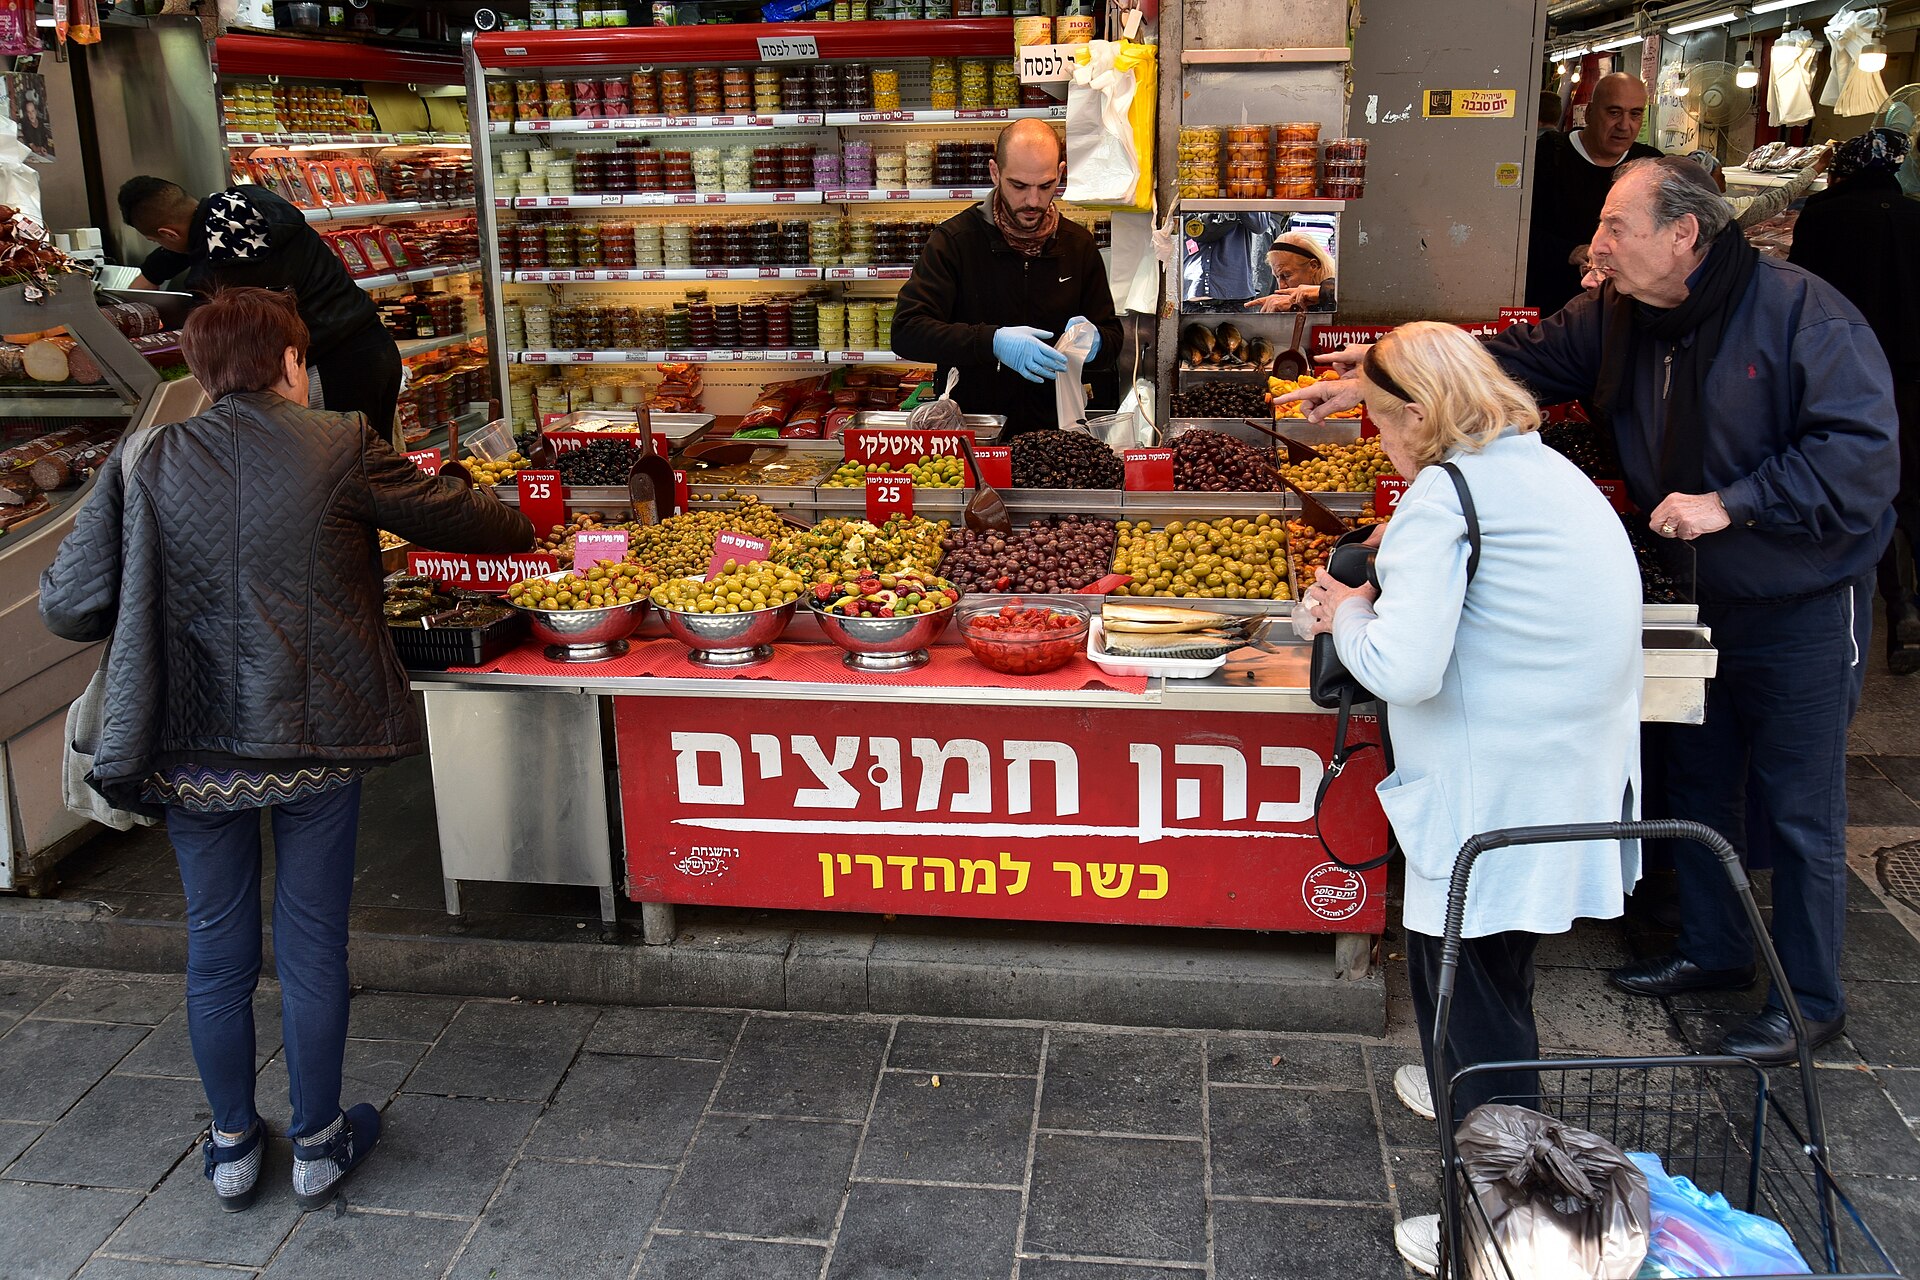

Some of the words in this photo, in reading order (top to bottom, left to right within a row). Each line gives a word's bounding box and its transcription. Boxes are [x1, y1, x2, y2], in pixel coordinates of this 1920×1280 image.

[1069, 20, 1092, 28] nora
[762, 40, 789, 56] לפסח
[792, 43, 816, 55] כשר
[1024, 48, 1063, 76] לפסח
[1471, 91, 1480, 100] לך
[1480, 92, 1502, 100] שיהיה
[1461, 99, 1490, 111] סבבה
[1492, 99, 1508, 111] יום
[748, 116, 756, 124] 10
[882, 113, 890, 121] 10
[868, 268, 877, 276] 10
[734, 351, 742, 359] 10
[859, 431, 925, 459] איטלקי
[930, 435, 958, 455] זית
[1148, 452, 1171, 461] קלמטה
[866, 476, 883, 484] לימון
[1380, 480, 1400, 488] חריף
[529, 483, 551, 499] 25
[877, 486, 901, 503] 25
[720, 534, 735, 545] שום
[735, 537, 746, 549] עם
[745, 539, 764, 552] זיתים
[414, 557, 472, 582] ביתיים
[476, 555, 551, 583] ממולאים
[671, 731, 1080, 817] חמוצים
[1129, 742, 1325, 845] כהן
[818, 851, 1031, 898] למהדרין
[1053, 861, 1170, 900] כשר
